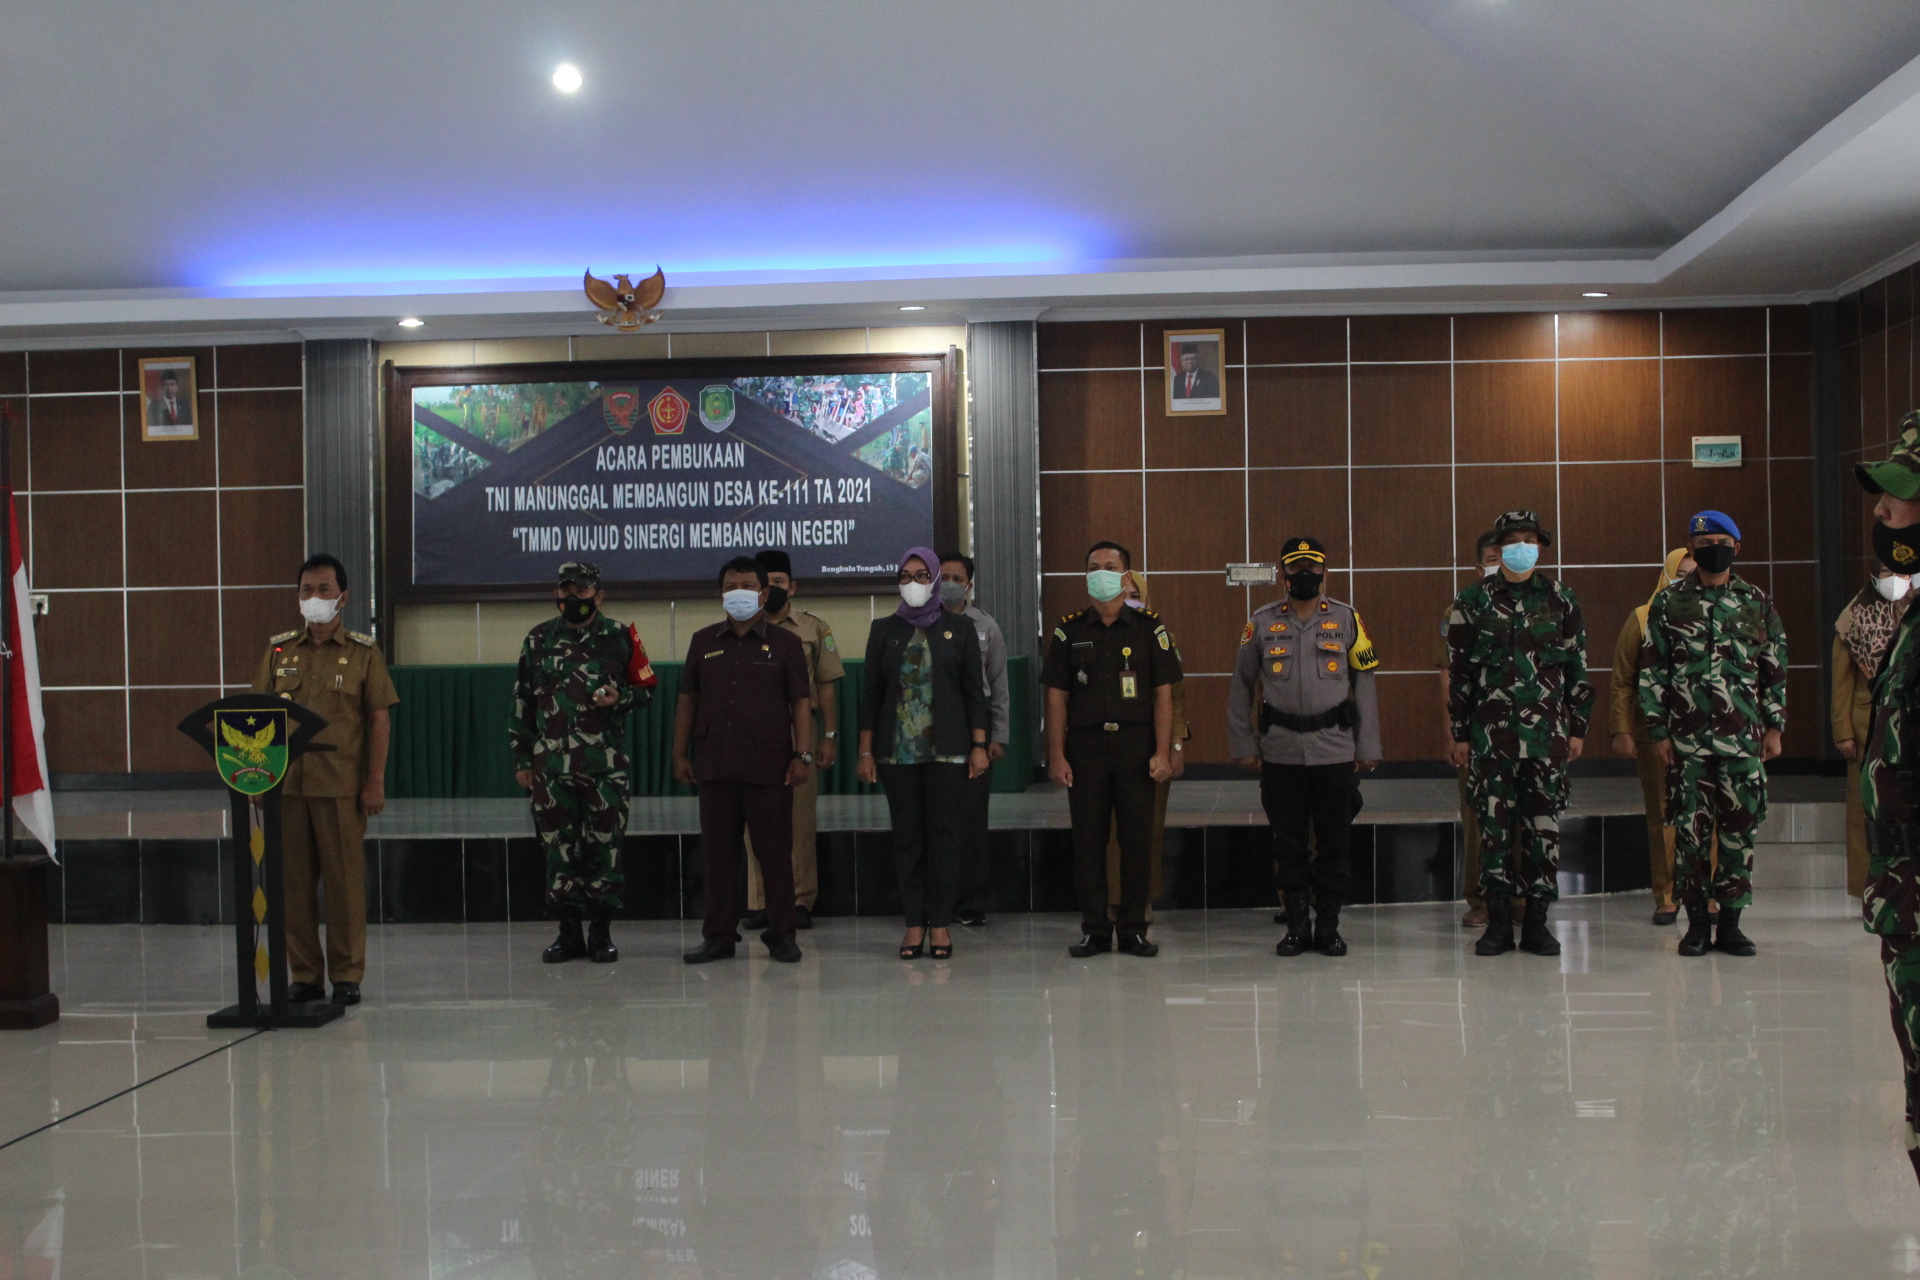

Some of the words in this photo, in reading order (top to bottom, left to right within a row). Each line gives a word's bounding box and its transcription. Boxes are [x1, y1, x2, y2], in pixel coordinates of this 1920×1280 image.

[595, 444, 647, 472] ACARA
[651, 441, 745, 470] PEMBUKAAN
[484, 486, 510, 512] TNI
[514, 483, 609, 512] MANUNGGAL
[612, 481, 709, 509] MEMBANGUN
[713, 479, 754, 507] DESA
[758, 478, 809, 506] KE-111
[813, 477, 834, 505] TA
[837, 476, 871, 504] 2021
[565, 524, 619, 551] WUJUD
[623, 523, 685, 550] SINERGI
[689, 520, 787, 549] MEMBANGUN
[821, 565, 856, 574] Bengkulu
[856, 564, 885, 573] Tengah,
